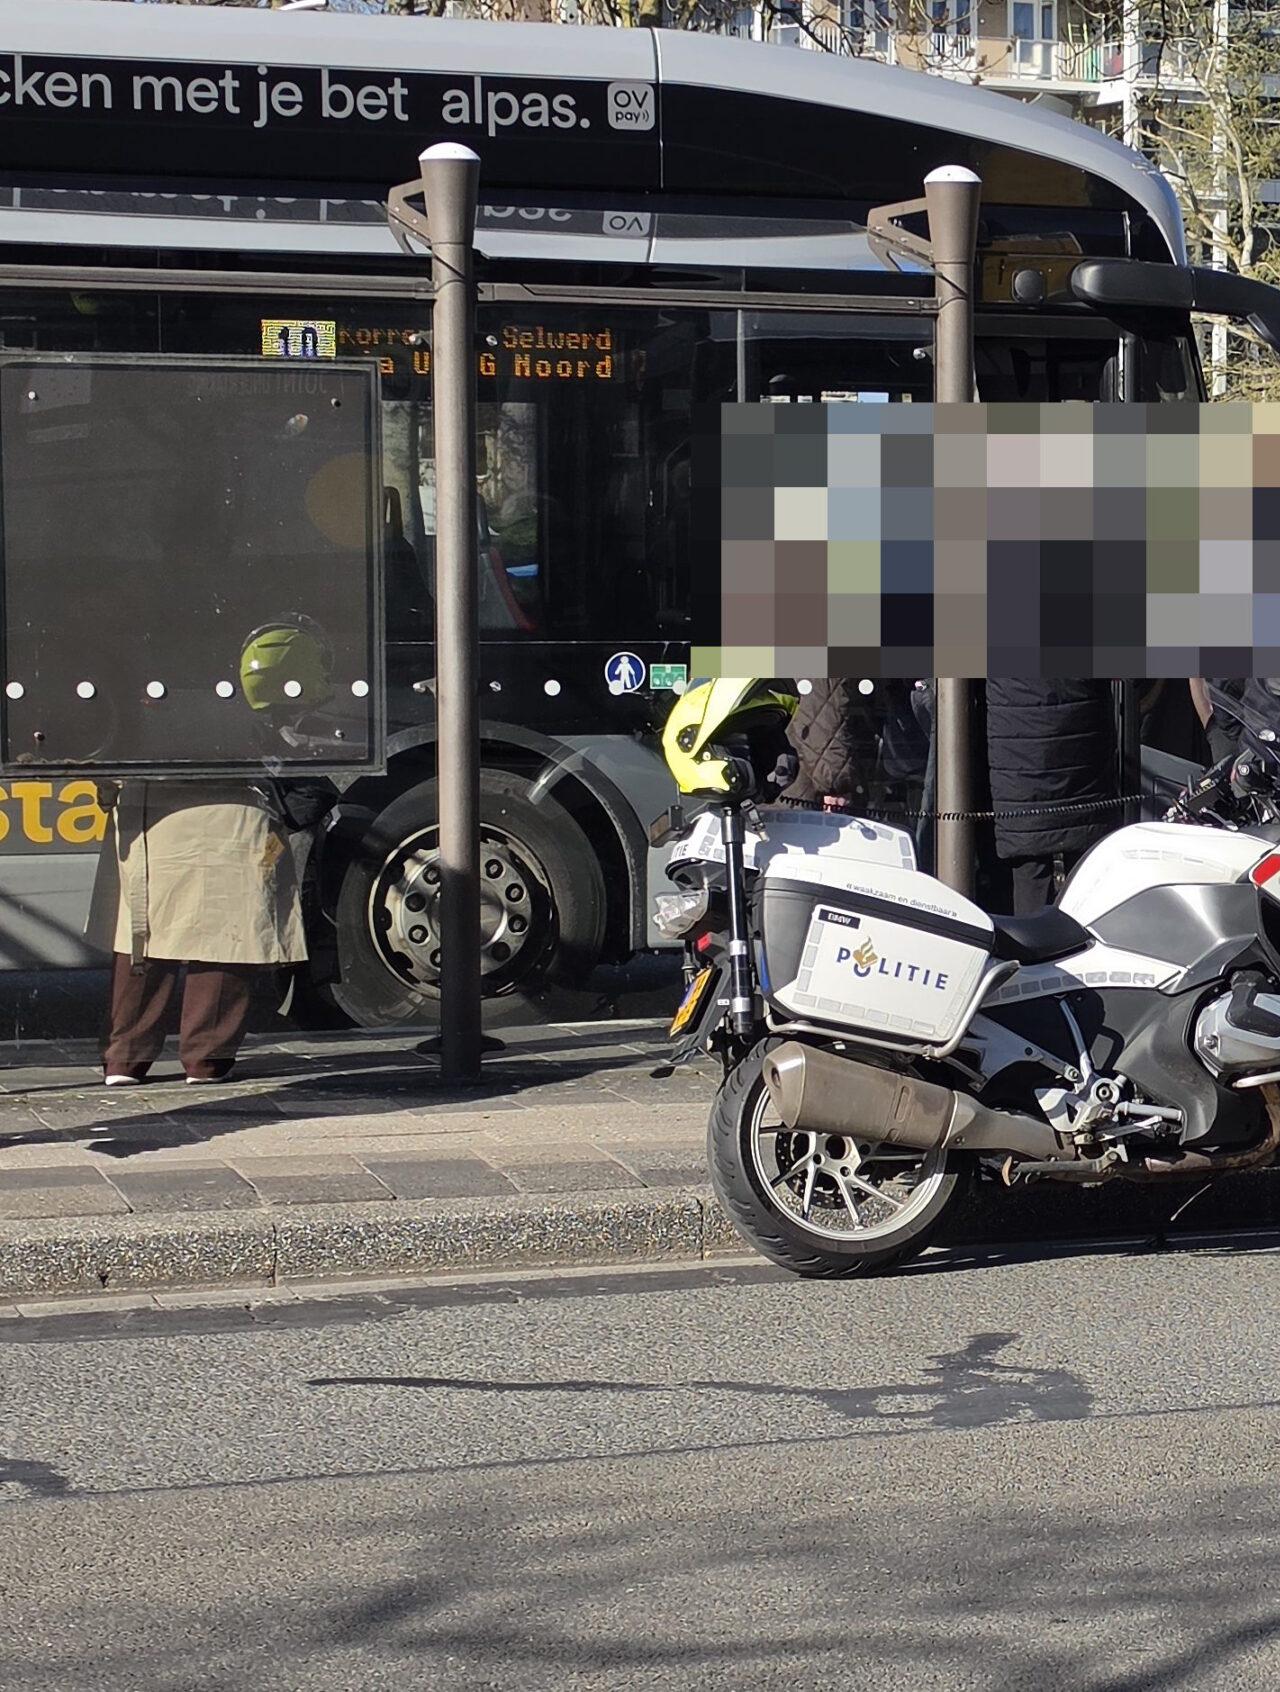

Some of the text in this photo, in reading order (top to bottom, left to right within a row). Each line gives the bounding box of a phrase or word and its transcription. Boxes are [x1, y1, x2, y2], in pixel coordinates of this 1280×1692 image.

[132, 69, 241, 114] met
[252, 64, 303, 128] je
[321, 68, 409, 122] bet
[441, 75, 591, 137] alpas.
[614, 90, 648, 108] OV
[616, 111, 640, 124] pay
[278, 326, 319, 357] 10
[503, 325, 613, 350] Selwerd
[514, 353, 613, 378] Noord
[0, 780, 109, 843] ta
[836, 946, 949, 990] POLITIE
